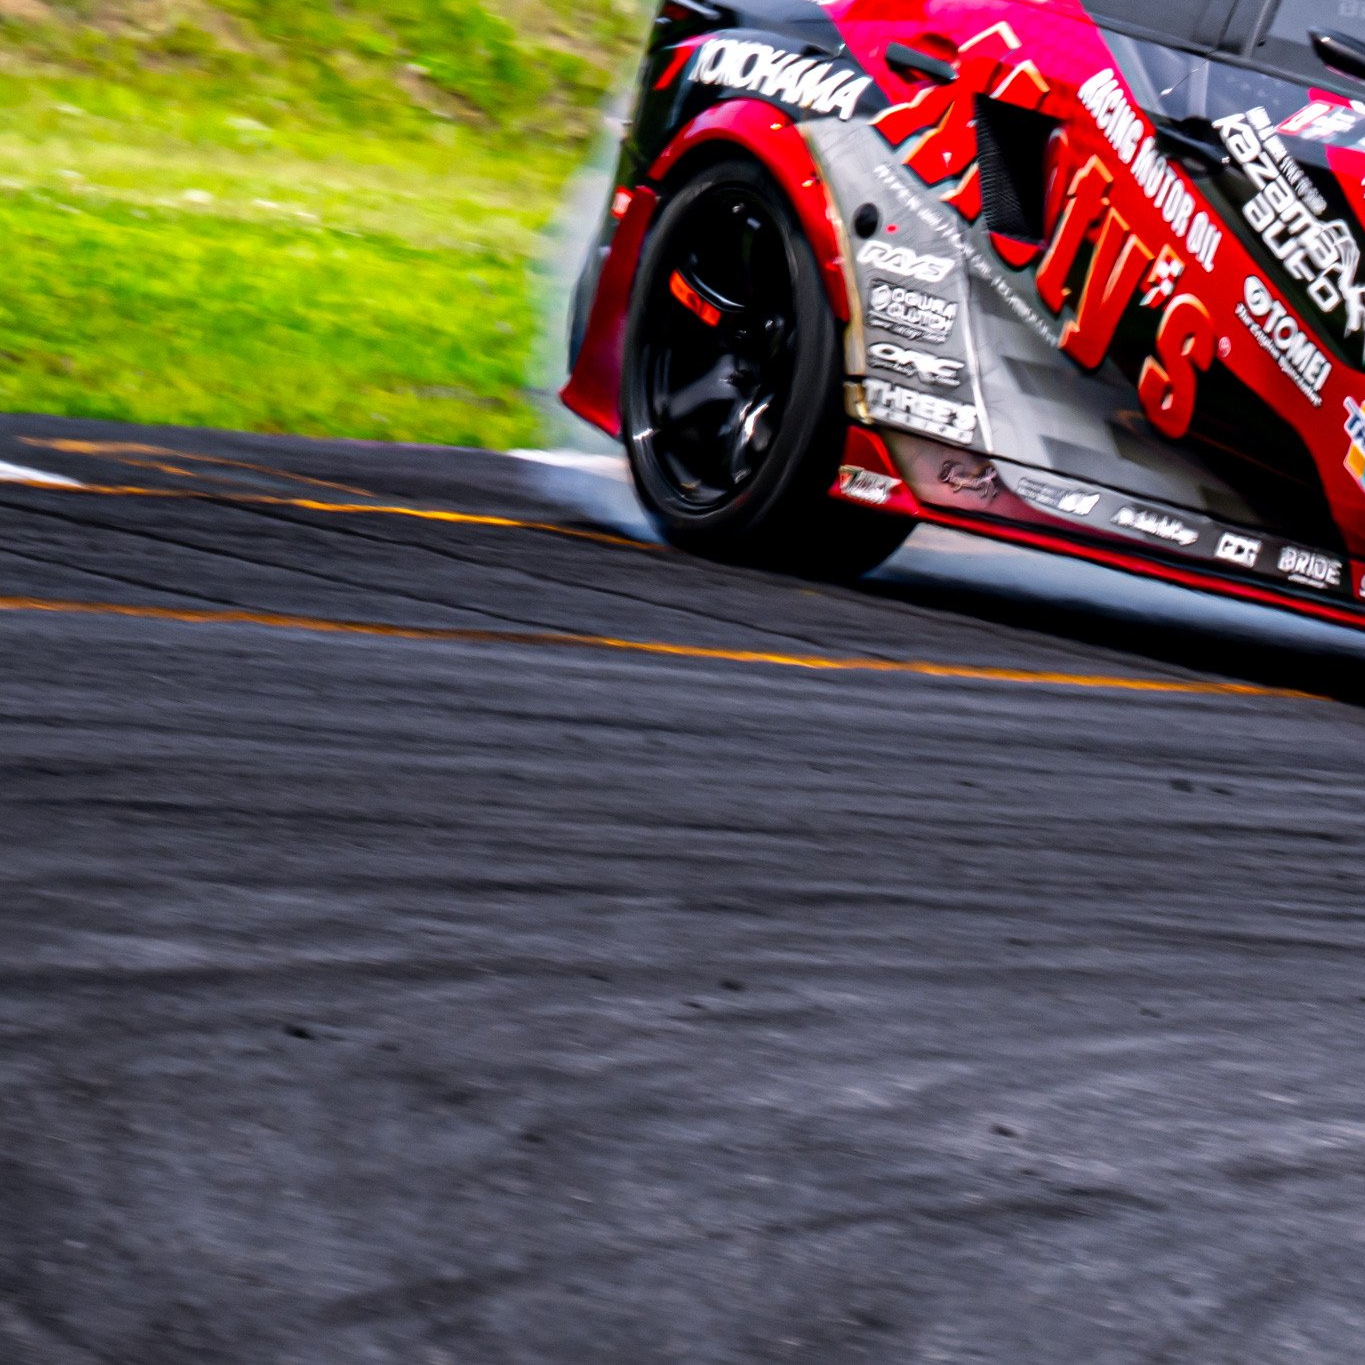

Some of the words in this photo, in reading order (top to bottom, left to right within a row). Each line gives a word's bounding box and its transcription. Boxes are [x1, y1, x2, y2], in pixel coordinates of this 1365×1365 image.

[688, 42, 873, 121] YOKOHAMA
[1077, 68, 1144, 164] RACING
[1131, 136, 1195, 237] MOTOR
[1186, 211, 1222, 272] OIL
[1212, 113, 1341, 270] kazama
[1242, 193, 1342, 313] auto
[1263, 300, 1332, 391] TOMEI
[1278, 546, 1342, 585] BRIDE
